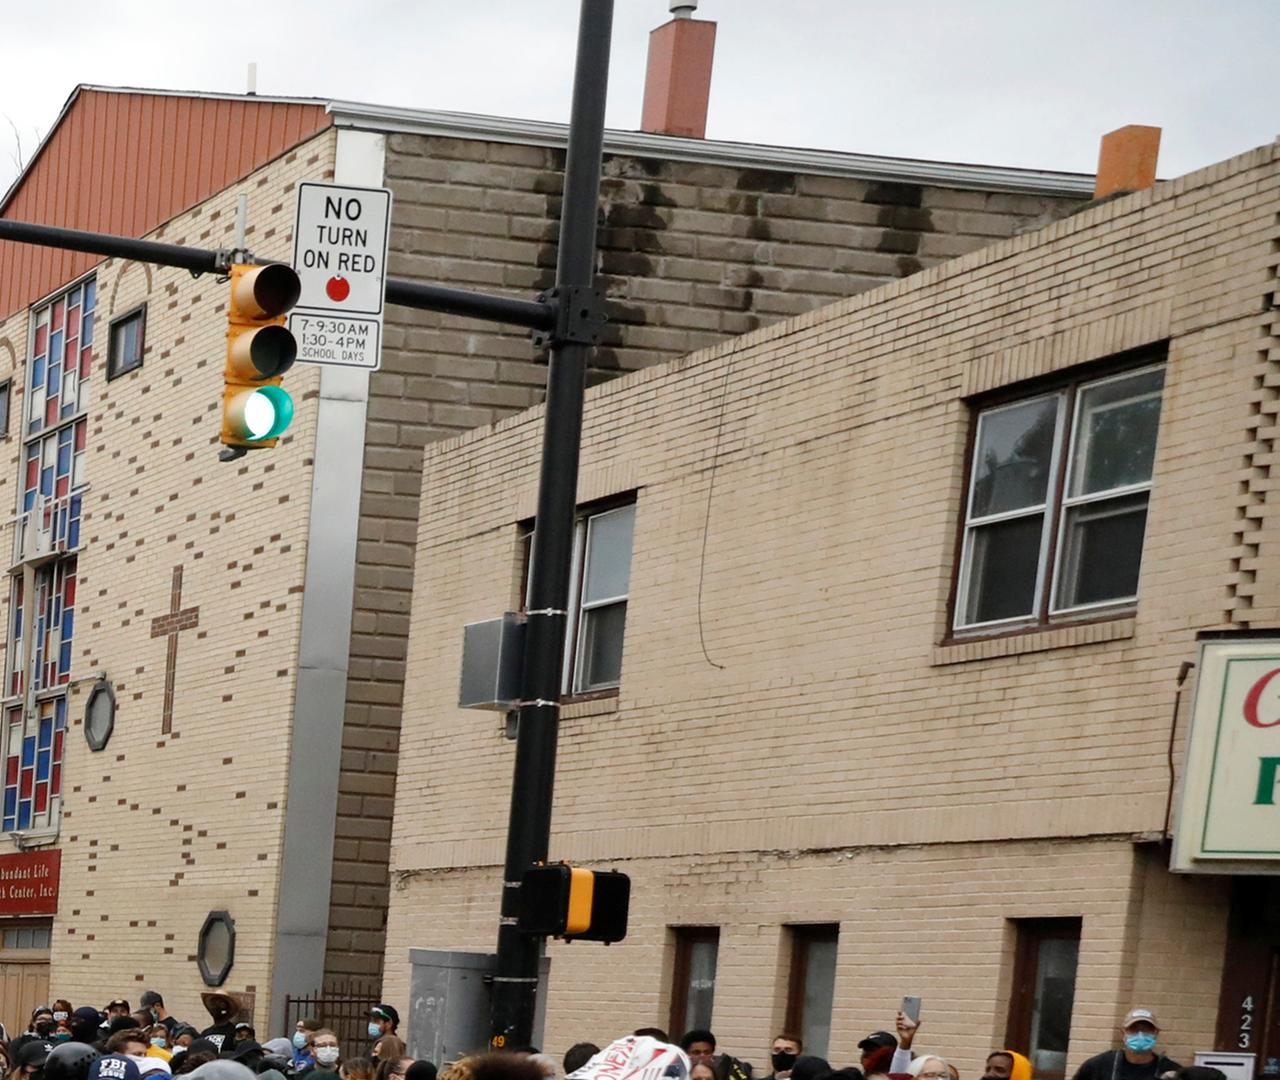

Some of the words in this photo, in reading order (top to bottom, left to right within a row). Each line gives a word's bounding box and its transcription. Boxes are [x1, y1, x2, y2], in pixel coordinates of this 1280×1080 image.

[325, 196, 362, 221] NO
[317, 225, 367, 247] TURN
[304, 249, 329, 269] ON
[338, 253, 376, 273] RED
[302, 347, 336, 360] SCHOOL
[342, 351, 365, 362] DAYS
[34, 864, 49, 877] Life
[492, 1035, 505, 1047] 49
[100, 1058, 127, 1071] FBI
